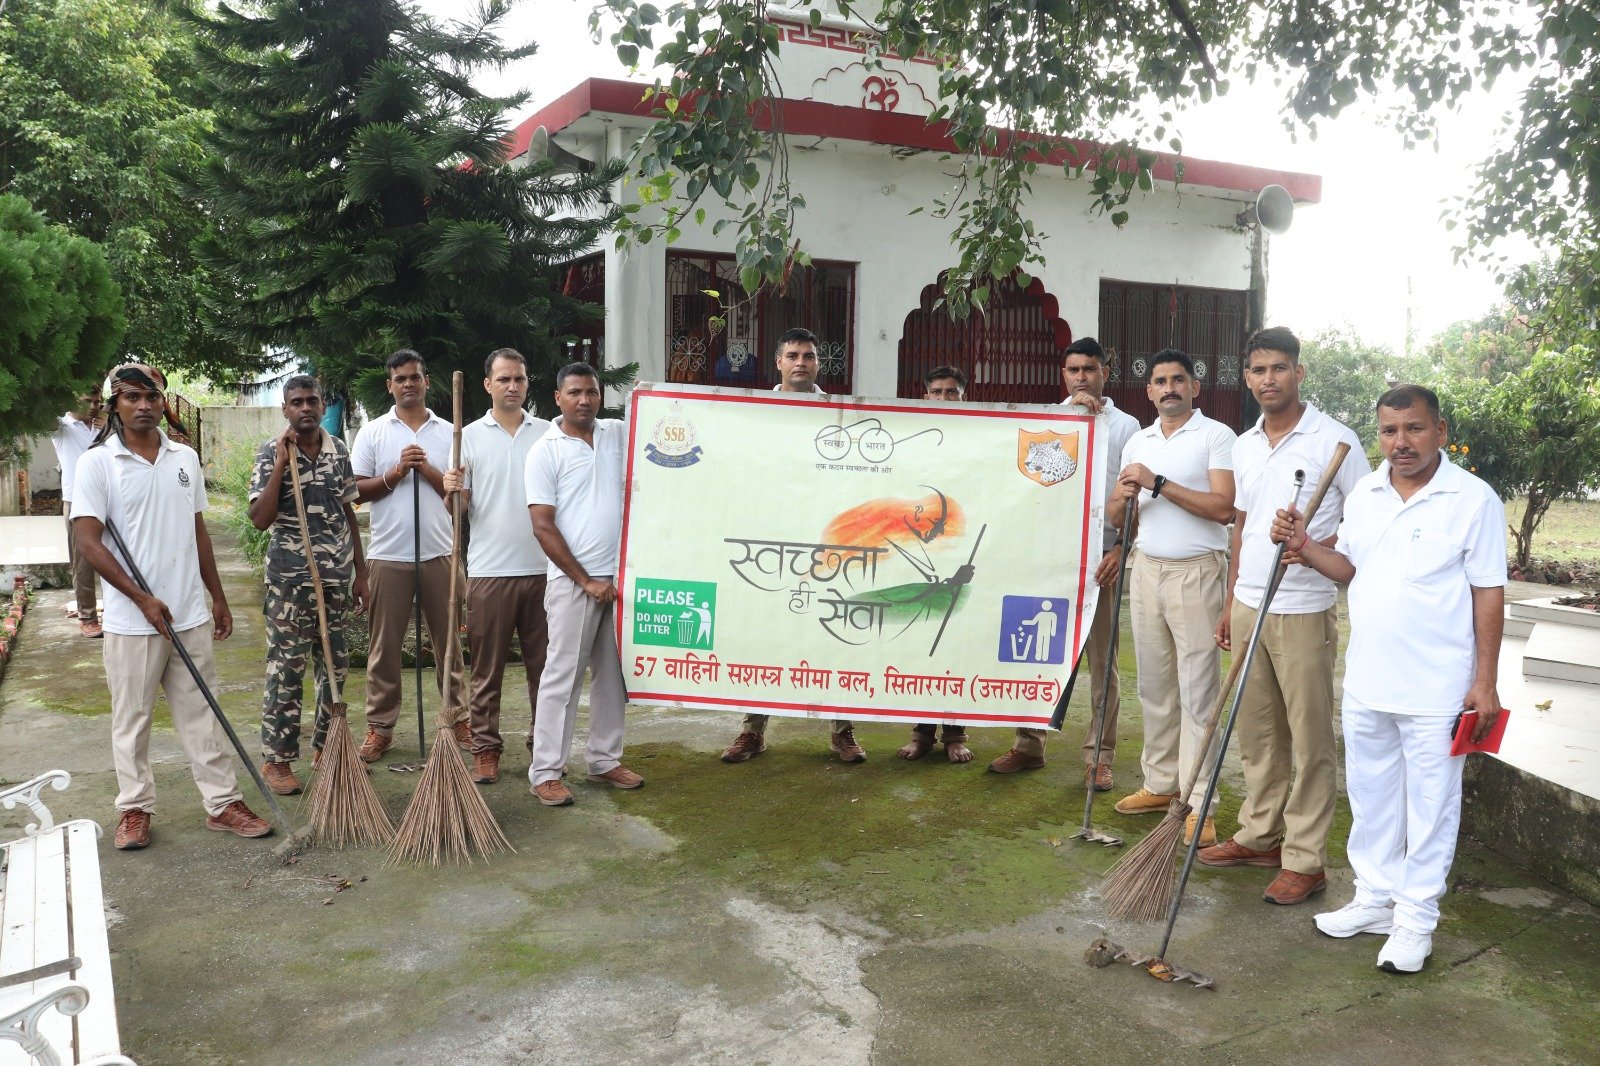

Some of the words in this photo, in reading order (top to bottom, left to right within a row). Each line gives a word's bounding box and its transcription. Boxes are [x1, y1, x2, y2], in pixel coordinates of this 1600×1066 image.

[664, 427, 685, 442] SSB
[865, 441, 886, 450] भारत
[816, 463, 827, 471] एक
[870, 465, 879, 473] की
[881, 466, 893, 474] ओर
[724, 538, 889, 592] स्वच्छता
[637, 588, 695, 606] PLEASE
[788, 581, 816, 614] ही
[637, 612, 650, 622] DO
[654, 613, 673, 624] NOT
[818, 588, 892, 645] सेवा
[639, 623, 670, 635] LITTER
[633, 656, 657, 677] 57
[664, 652, 721, 684] वाहिनी
[727, 663, 783, 687] सशस्त्र
[789, 660, 832, 689] सीमा
[837, 671, 874, 698] बल,
[884, 666, 965, 697] सितारगंज
[970, 674, 1061, 706] (उत्तराखंड)
